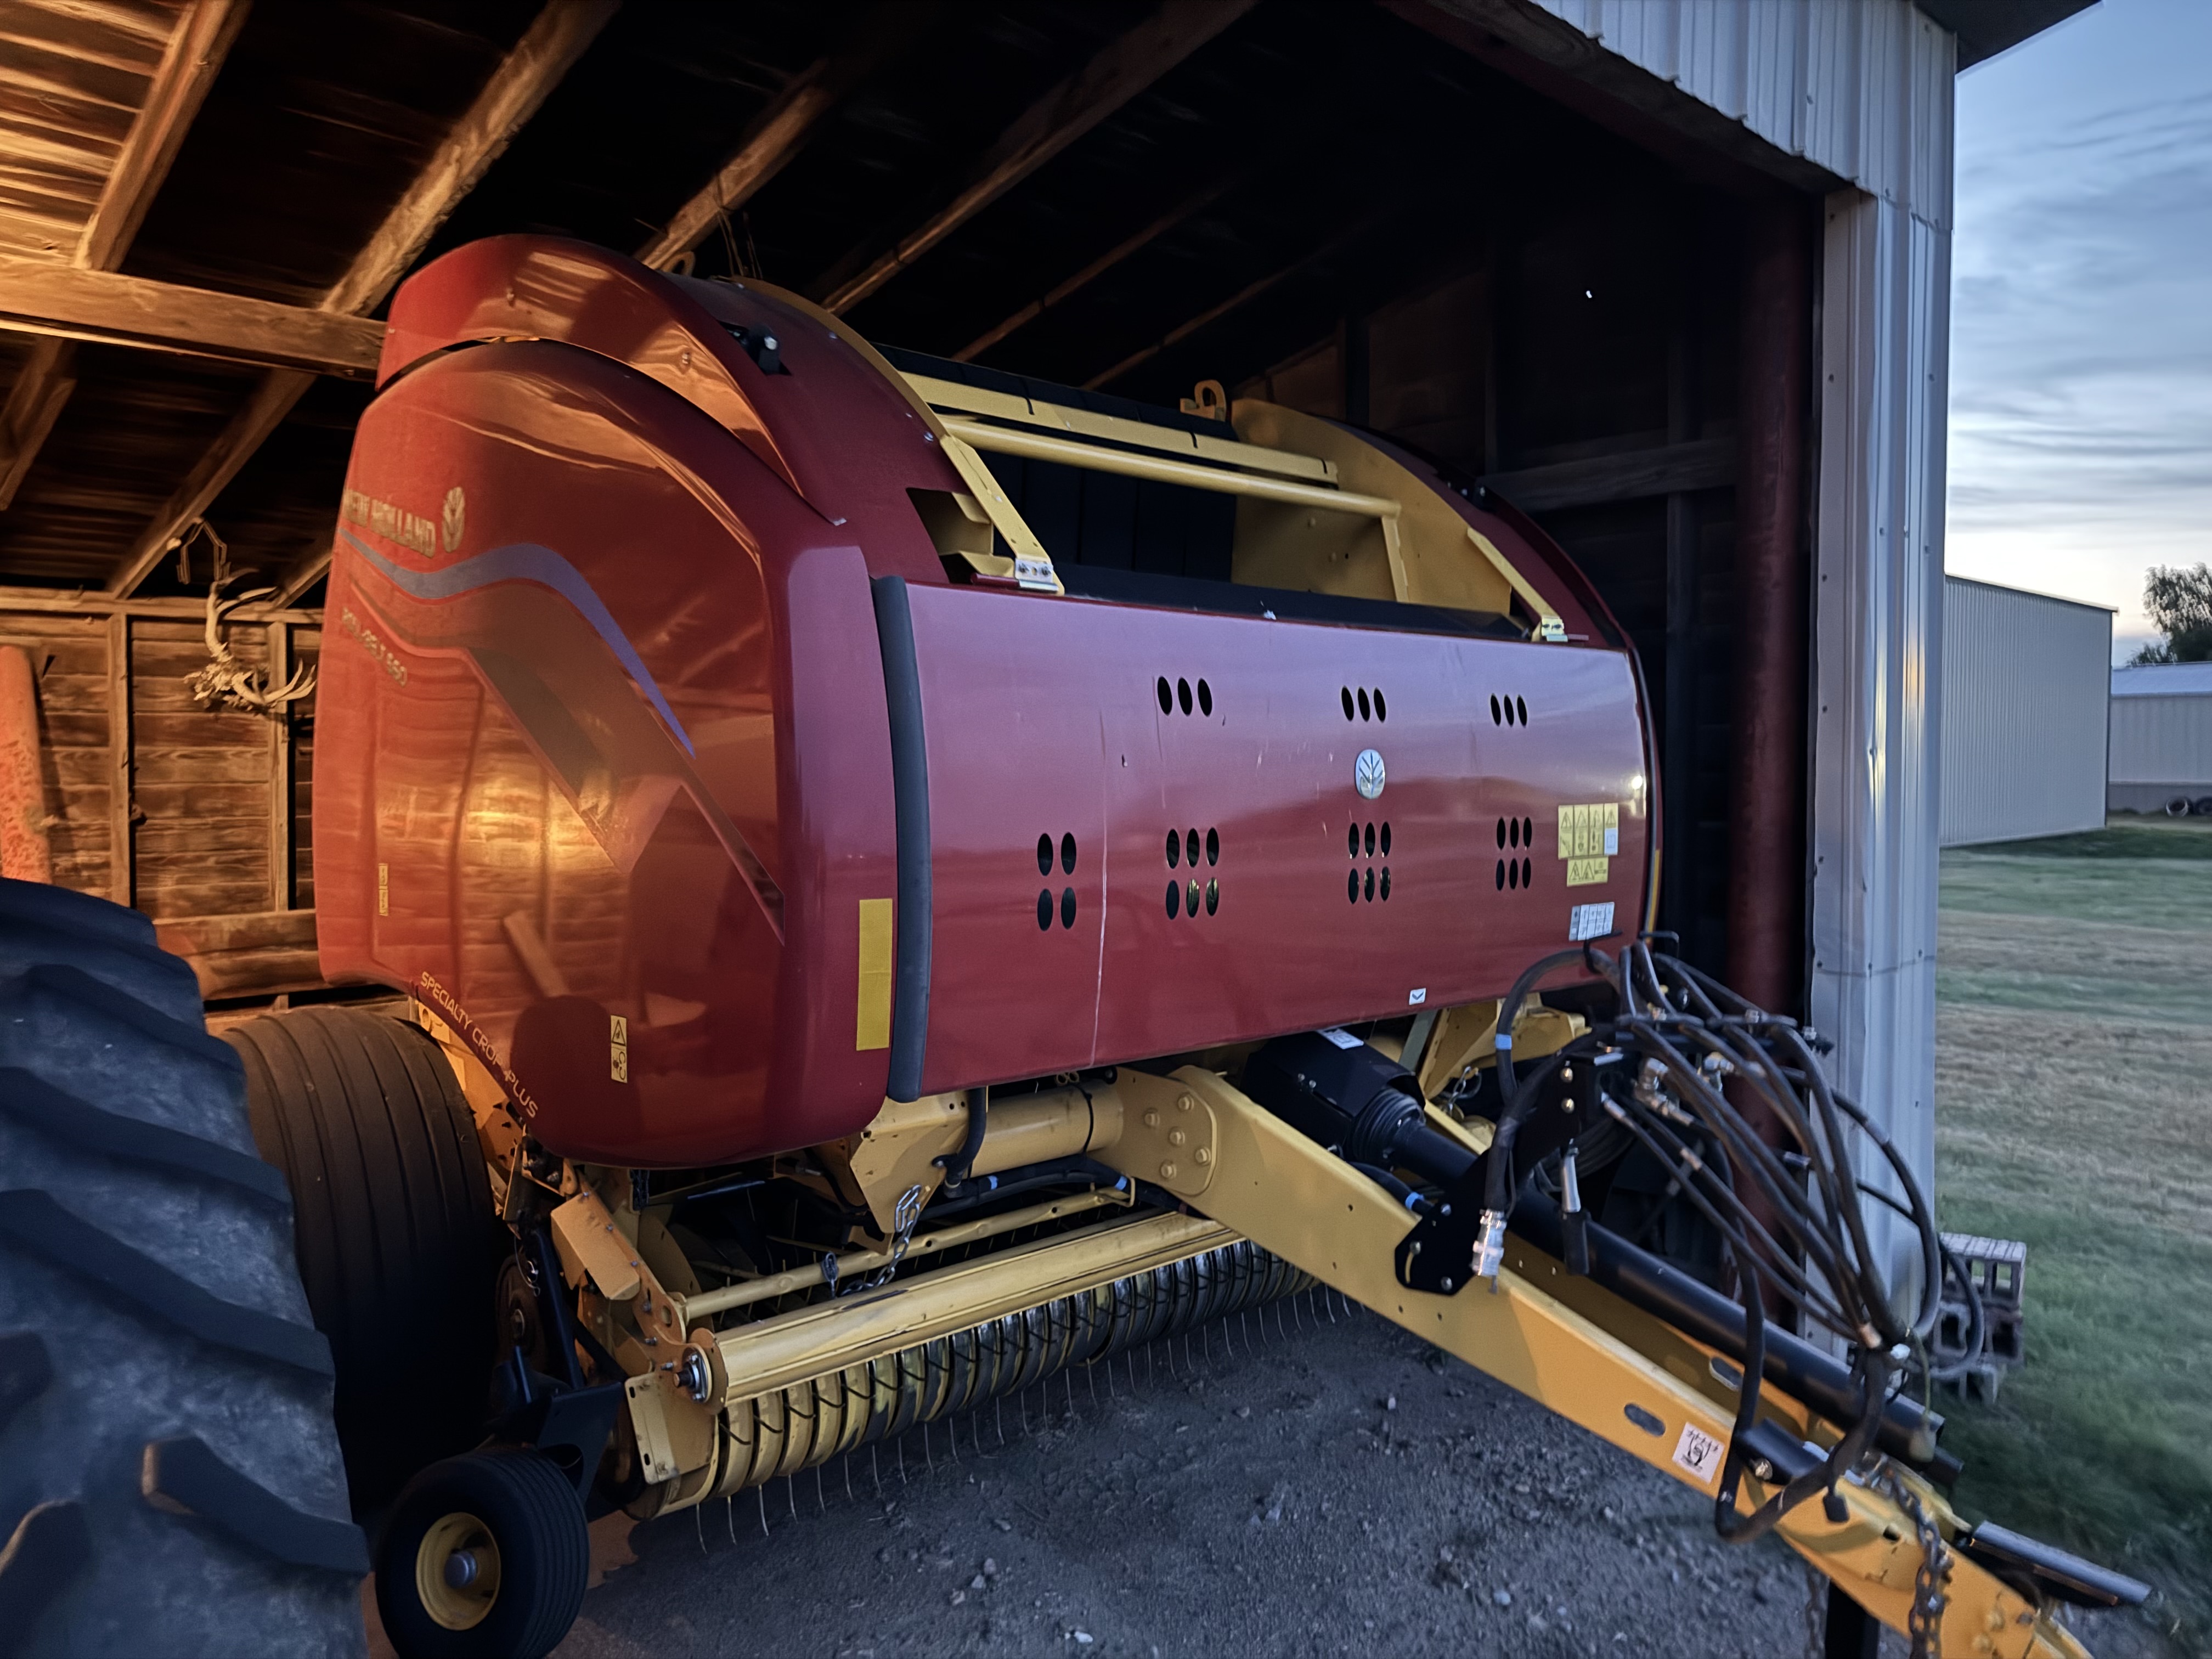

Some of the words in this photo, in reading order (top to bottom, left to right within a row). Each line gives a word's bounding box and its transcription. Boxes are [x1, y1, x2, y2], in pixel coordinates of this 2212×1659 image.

[370, 498, 436, 558] HOLLAND
[420, 971, 472, 1030] SPECIALTY
[472, 1027, 503, 1065] CROP
[504, 1069, 538, 1119] PLUS
